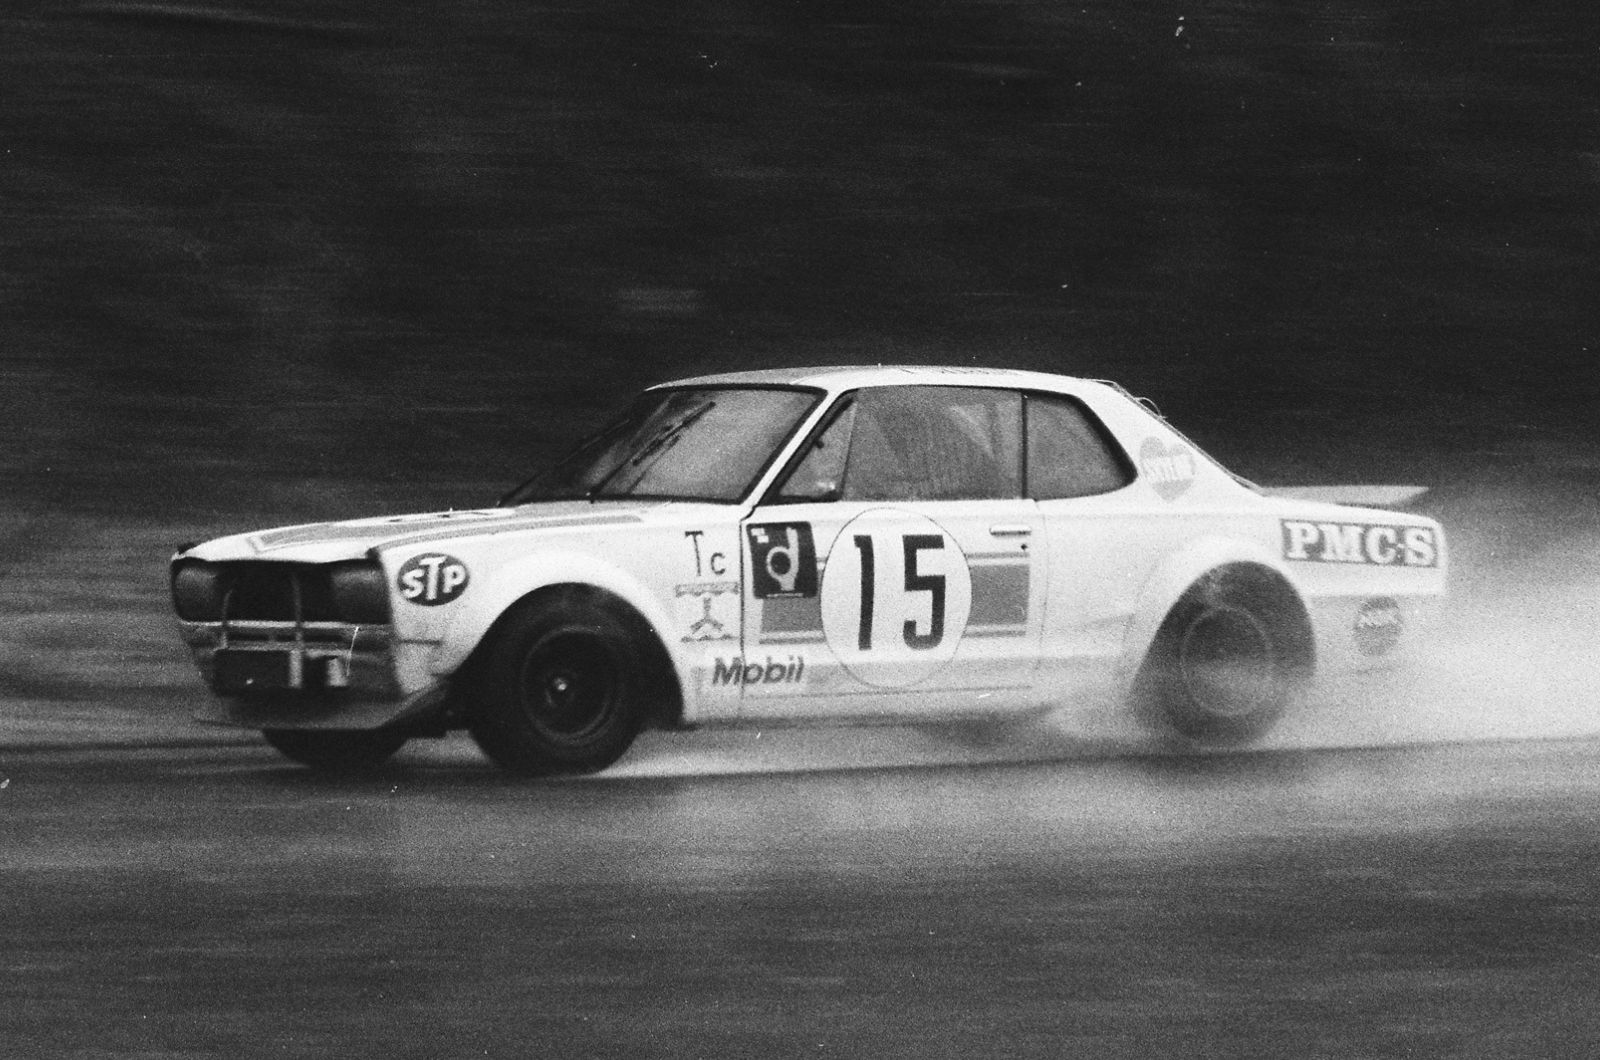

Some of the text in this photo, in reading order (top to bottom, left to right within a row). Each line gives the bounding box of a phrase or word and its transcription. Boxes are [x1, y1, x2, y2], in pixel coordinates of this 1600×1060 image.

[403, 556, 465, 600] STP
[853, 534, 946, 651] 15
[712, 656, 805, 687] Mobil
